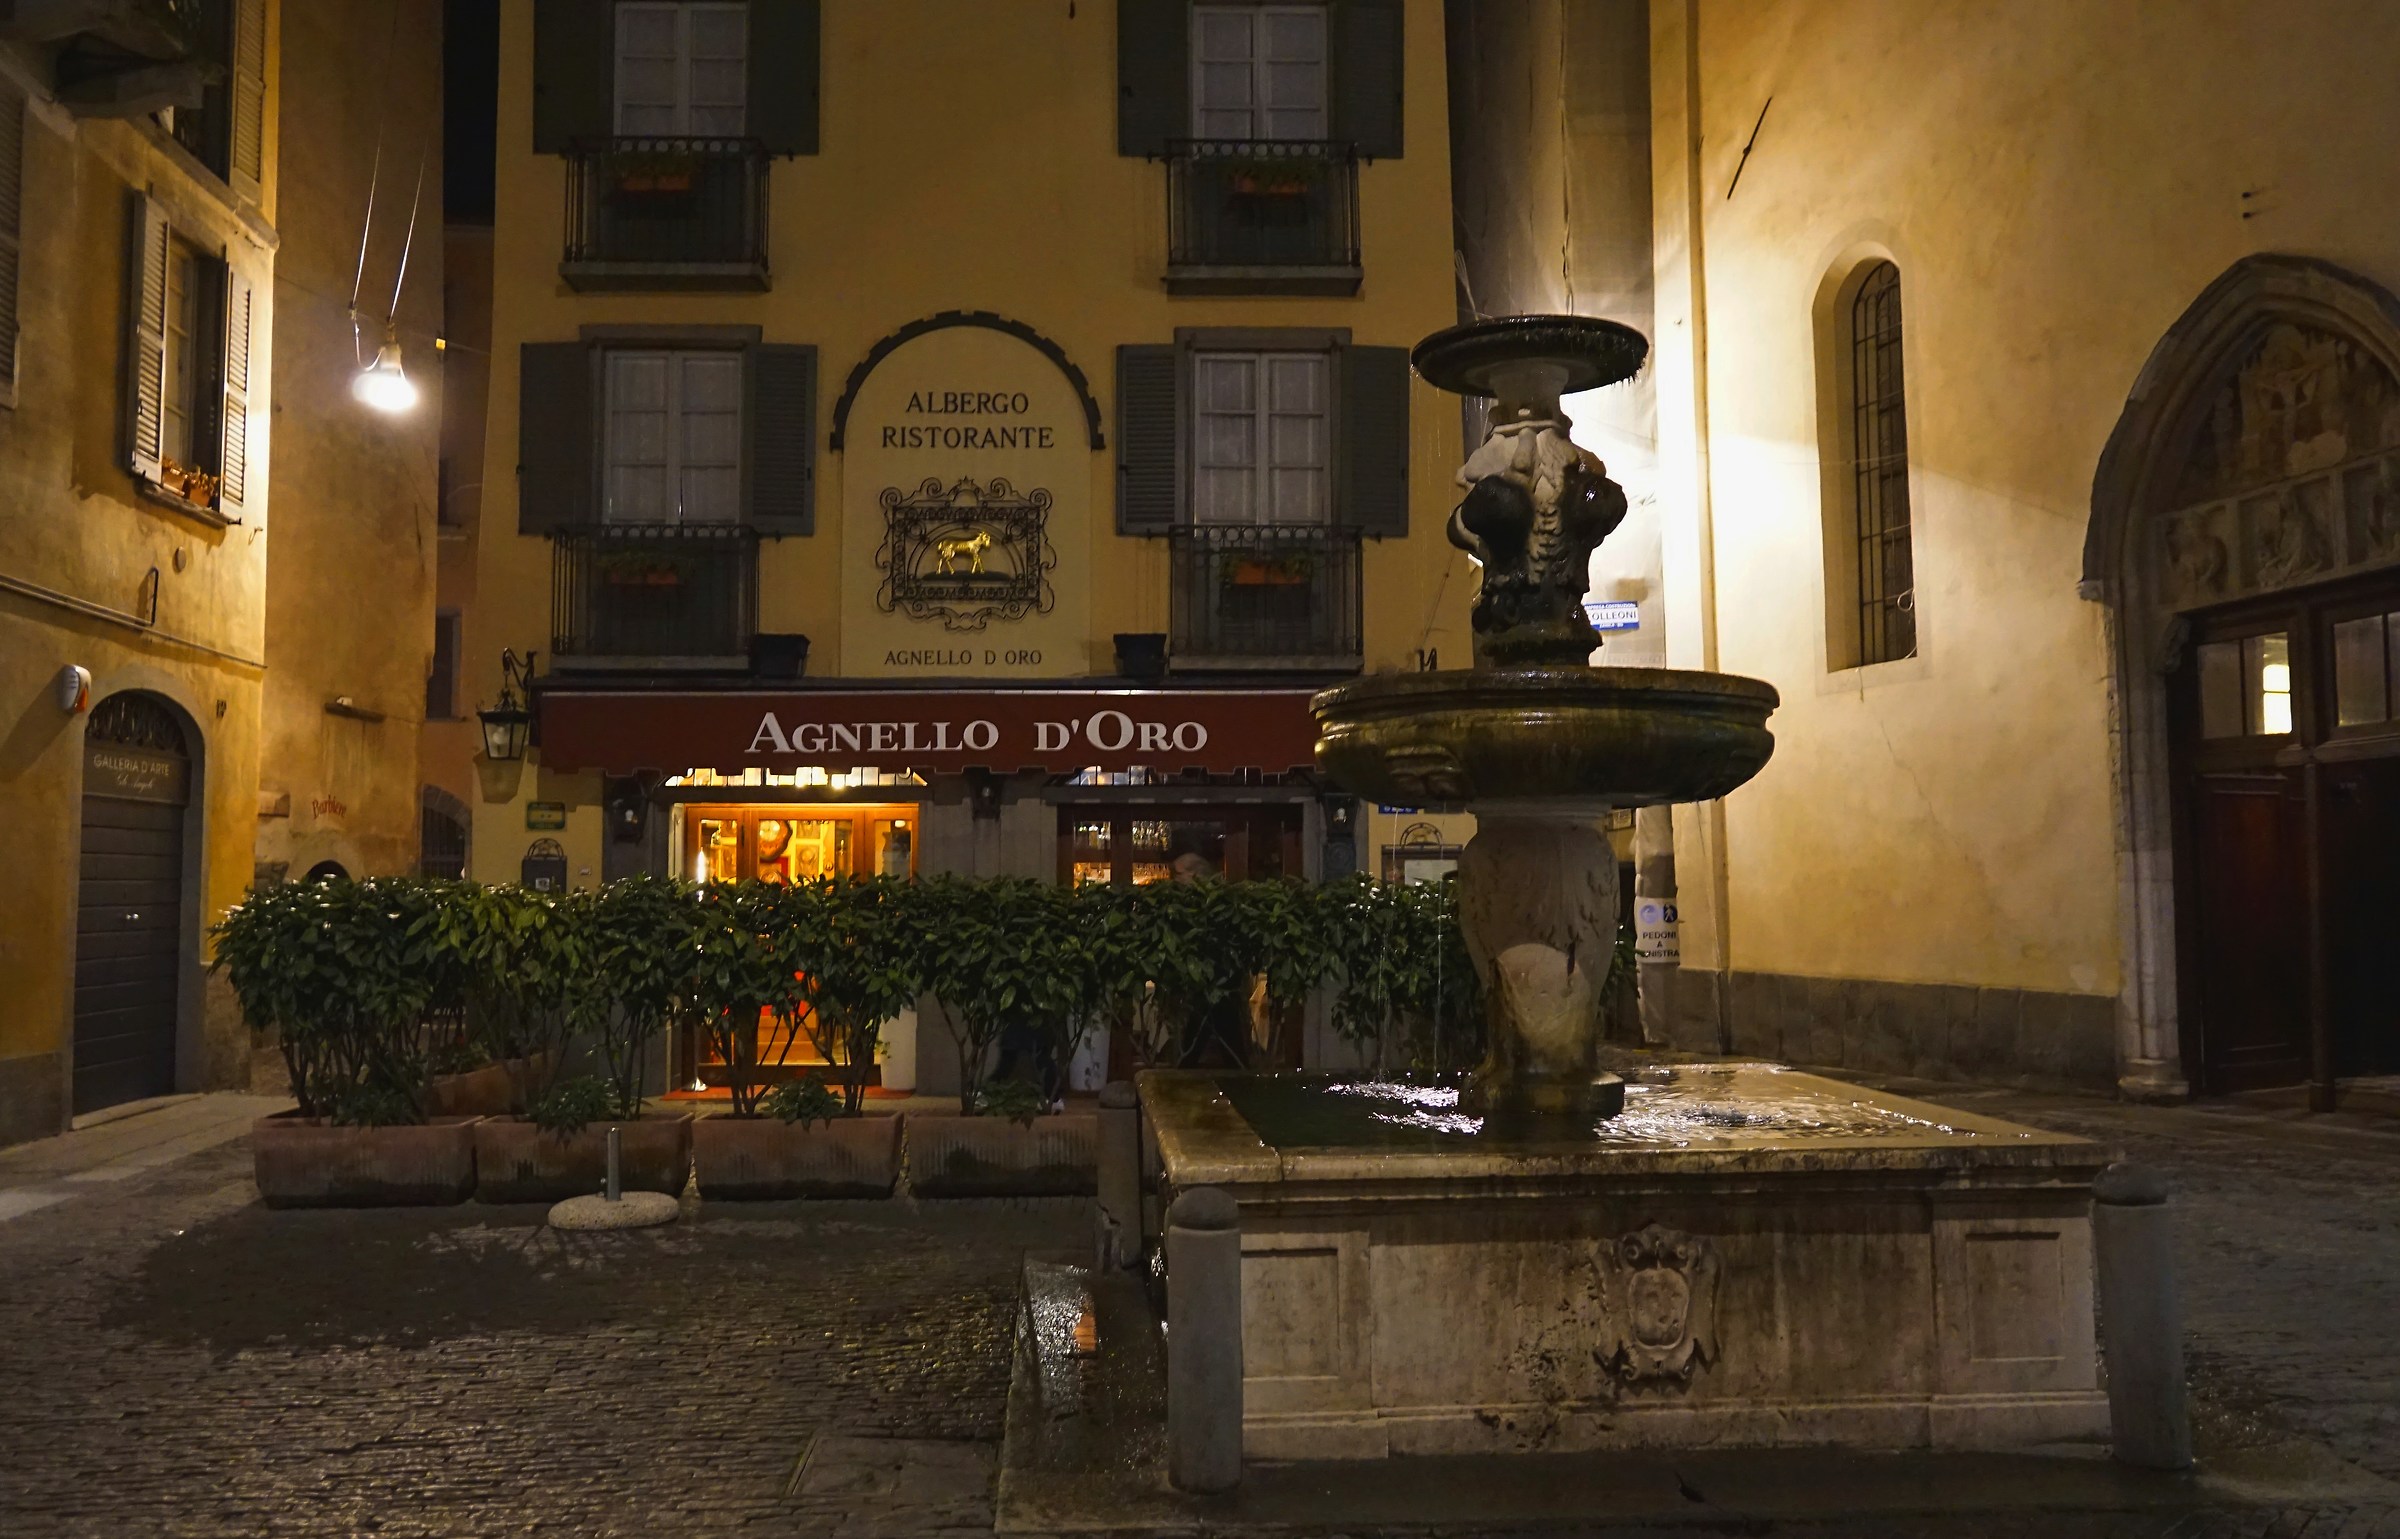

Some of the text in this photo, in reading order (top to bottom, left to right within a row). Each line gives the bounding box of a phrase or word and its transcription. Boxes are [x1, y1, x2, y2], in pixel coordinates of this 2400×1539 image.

[905, 391, 1029, 414] ALBERGO
[882, 425, 1054, 449] RISTORANTE
[1592, 611, 1636, 620] OLLEONI
[884, 650, 972, 666] AGNELLO
[1005, 650, 1042, 665] ORO
[93, 754, 139, 773] GALLERIA
[1643, 931, 1677, 939] PEDONI
[1657, 940, 1663, 948] A
